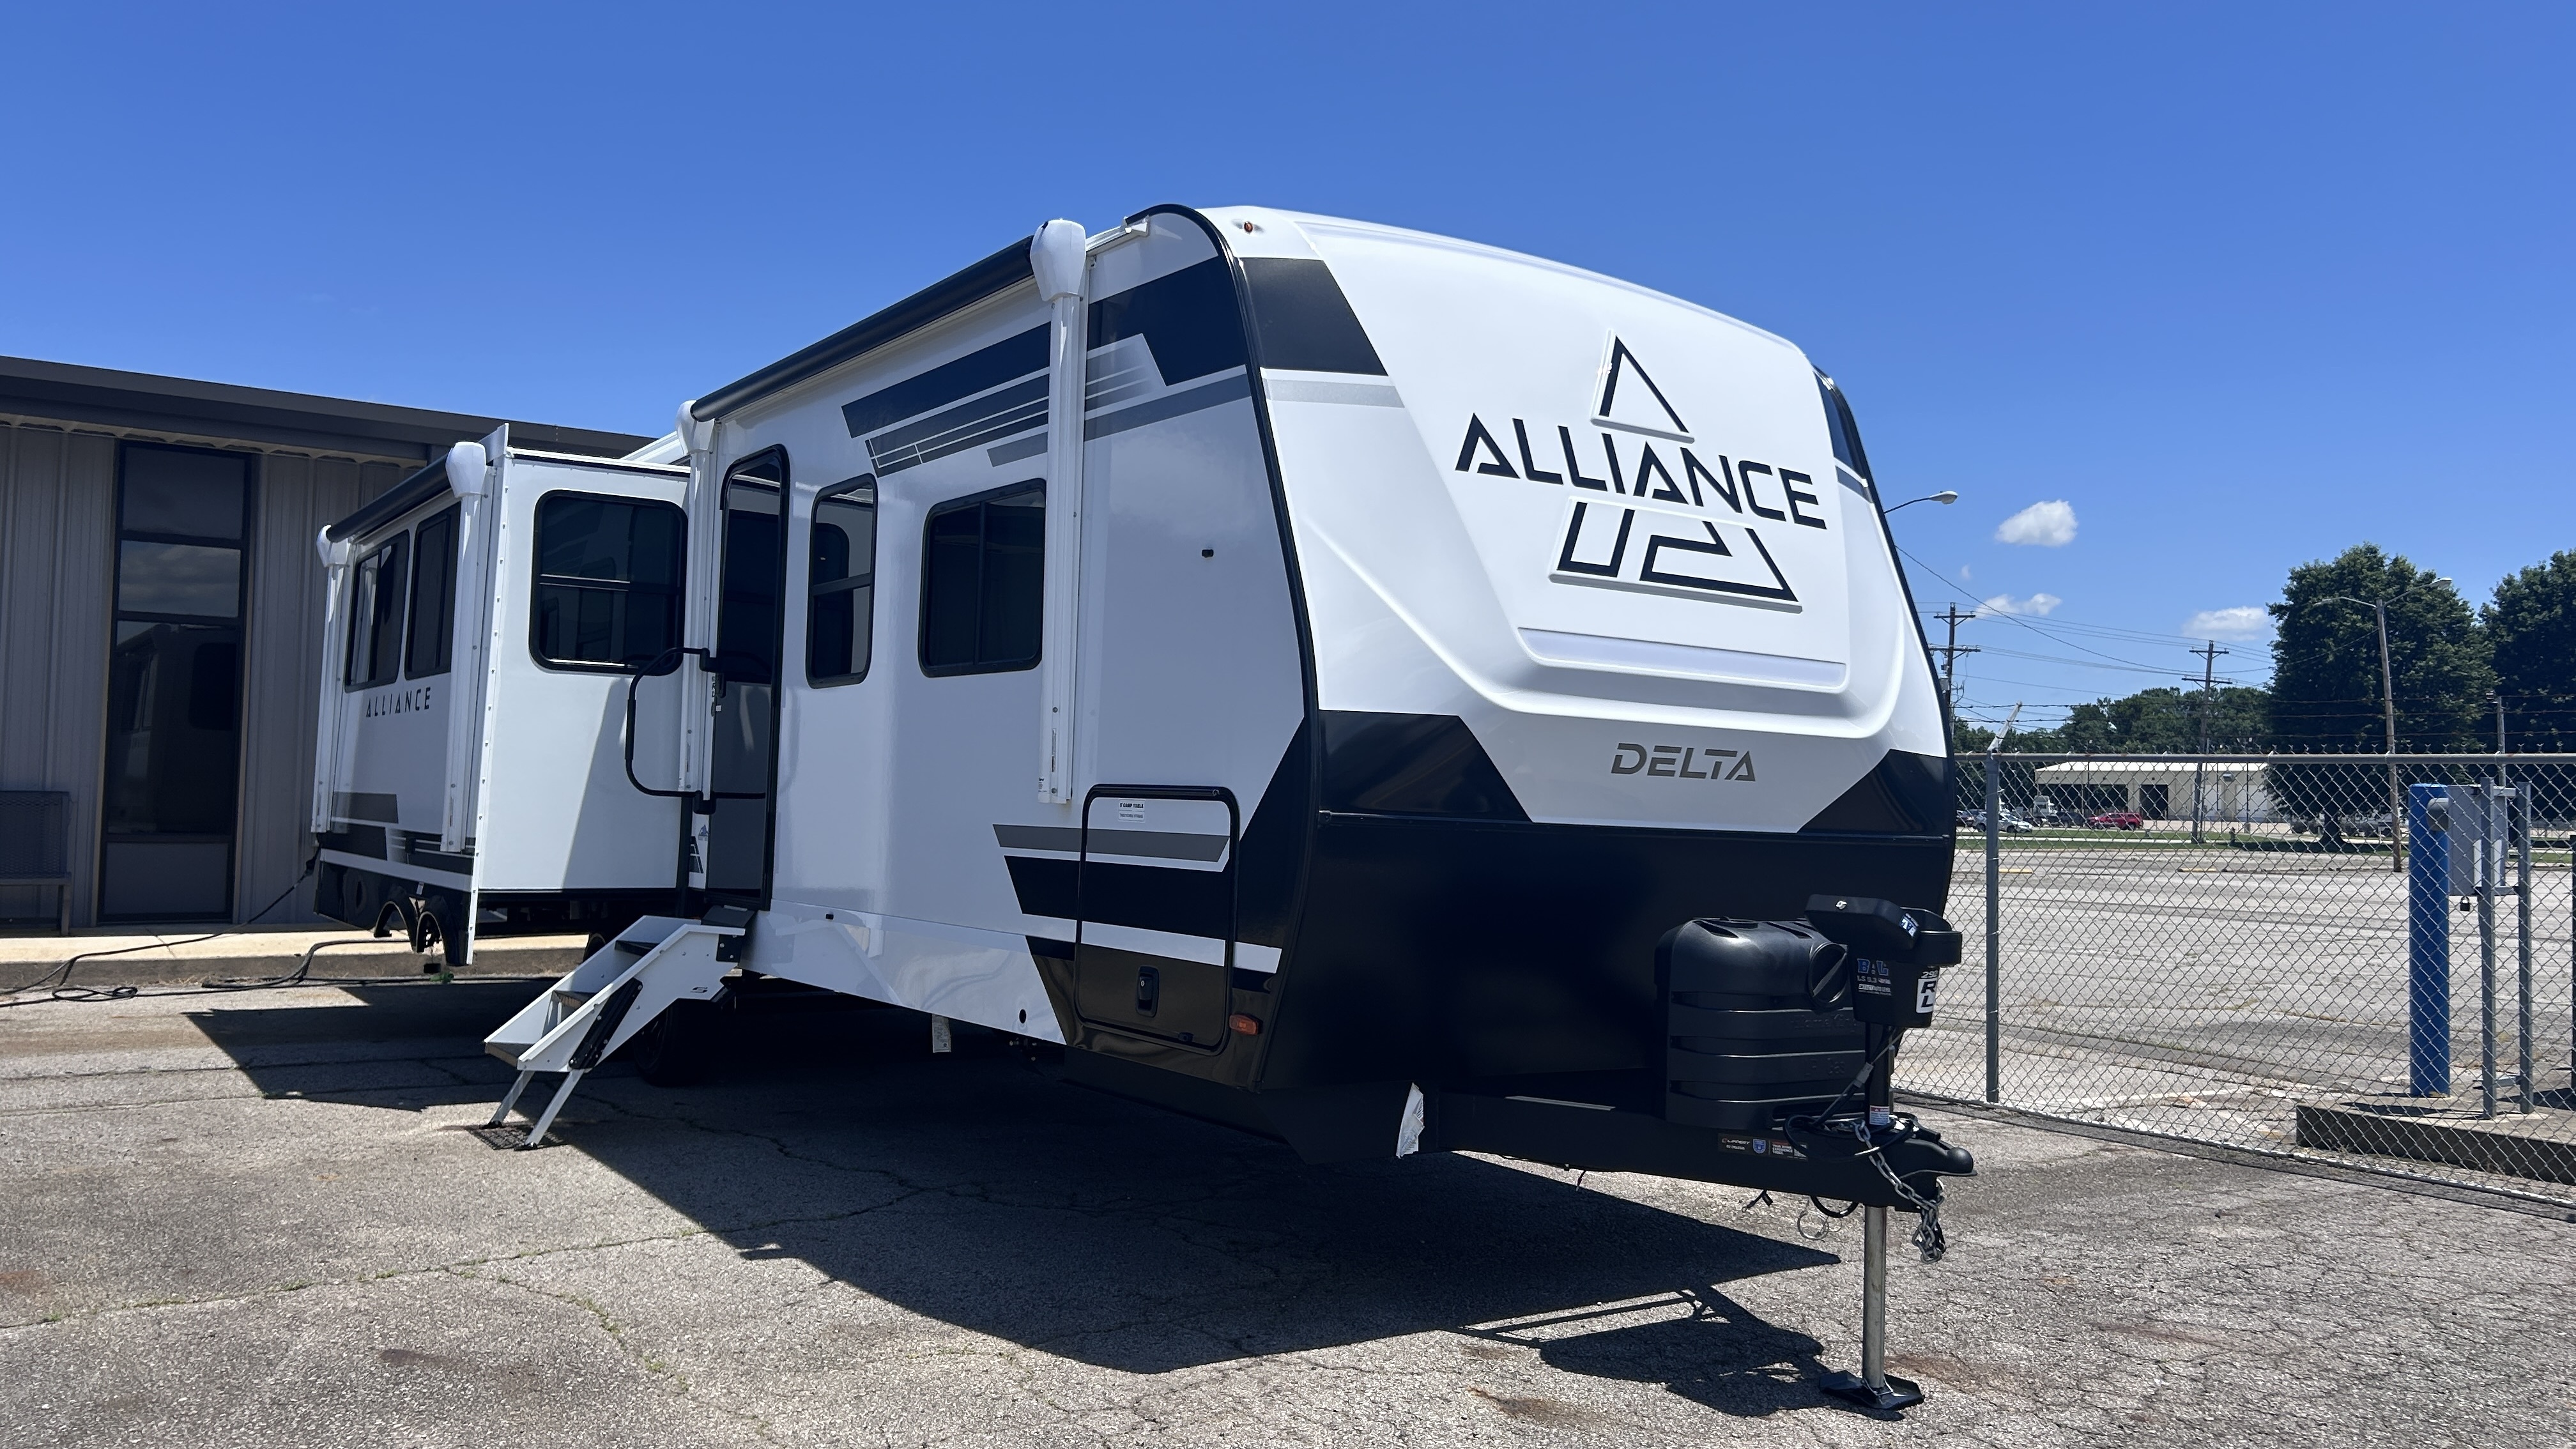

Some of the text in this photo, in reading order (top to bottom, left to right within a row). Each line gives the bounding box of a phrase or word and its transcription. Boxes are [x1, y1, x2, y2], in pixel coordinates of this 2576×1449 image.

[1455, 413, 1827, 530] ALLIANCE
[365, 686, 431, 717] ALLIANCE
[1611, 742, 1756, 782] DELTA
